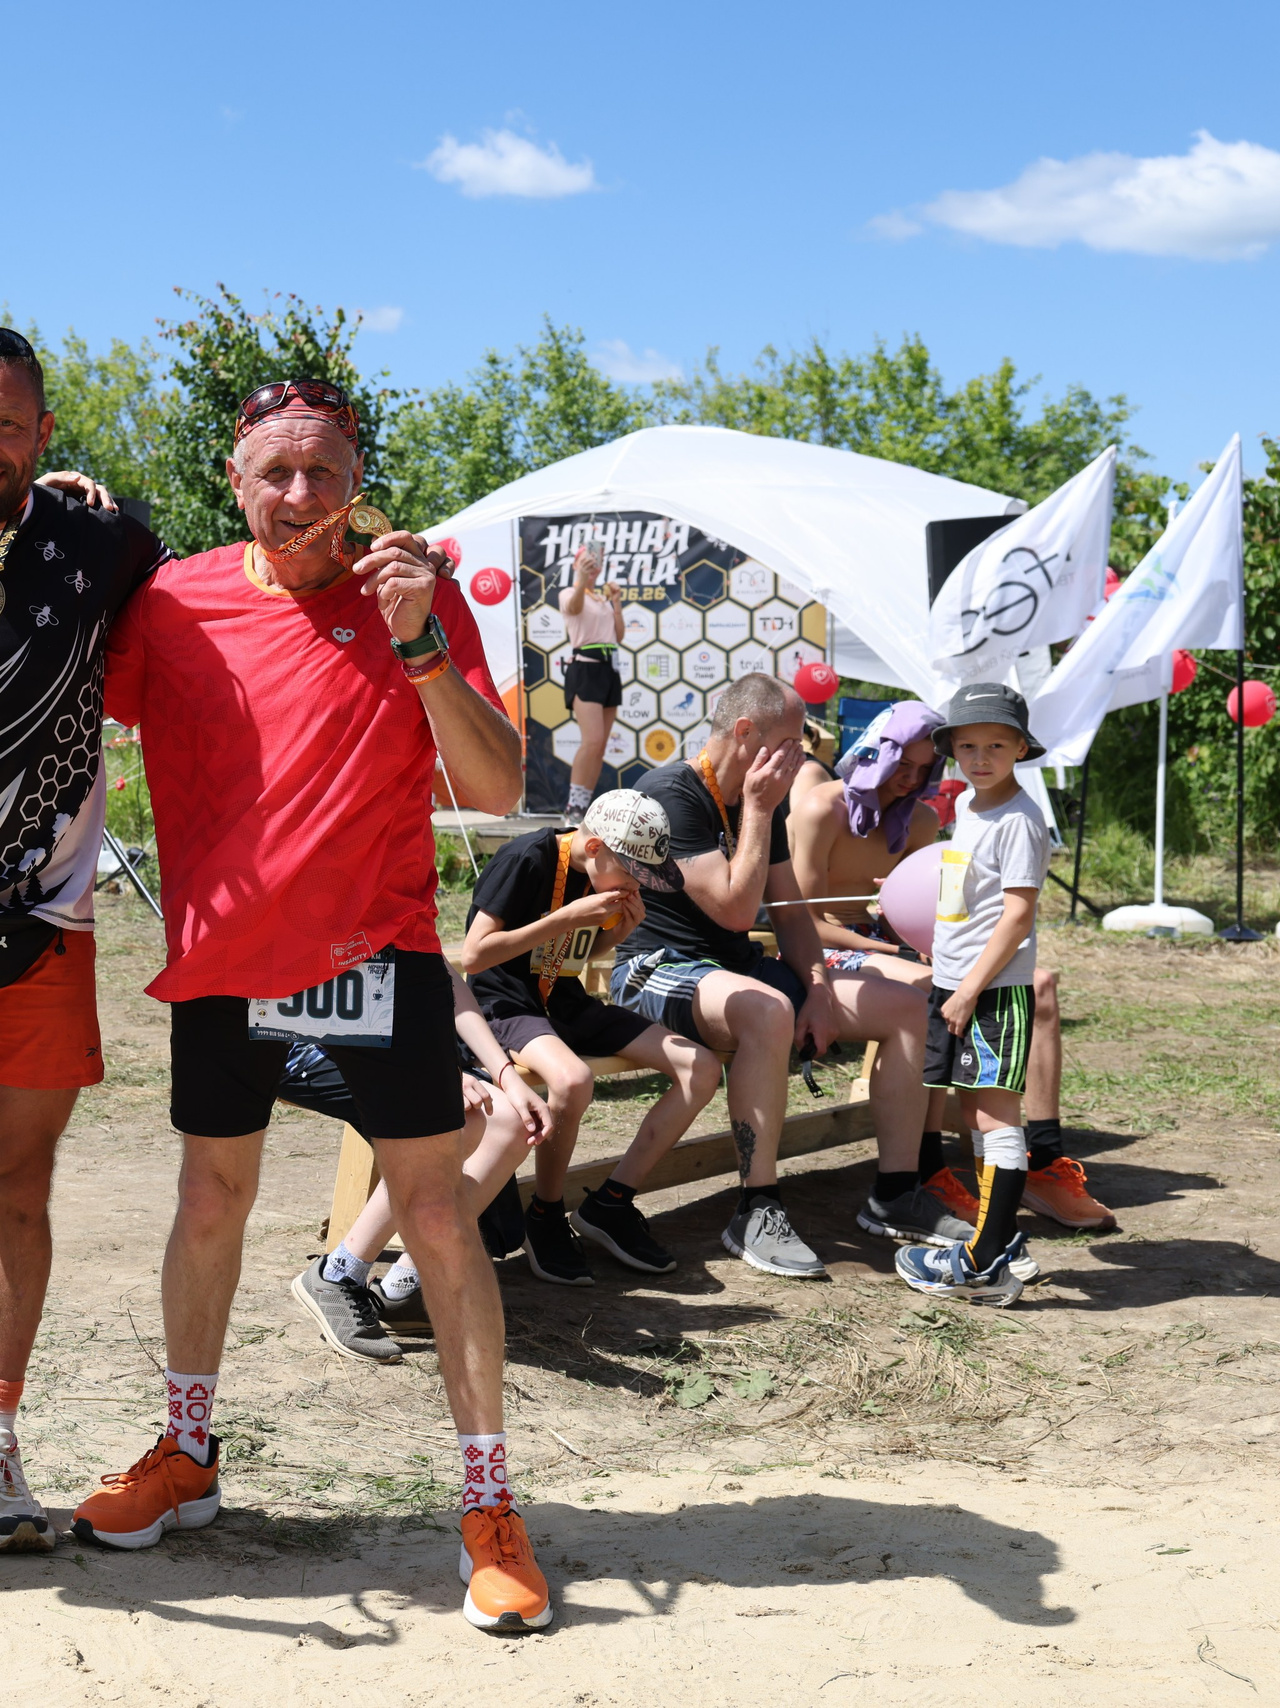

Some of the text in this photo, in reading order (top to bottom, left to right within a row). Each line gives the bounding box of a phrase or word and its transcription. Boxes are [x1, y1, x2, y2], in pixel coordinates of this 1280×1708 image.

[557, 552, 680, 587] ПЕЛА
[622, 710, 650, 719] FLOW
[603, 807, 636, 824] SWEET
